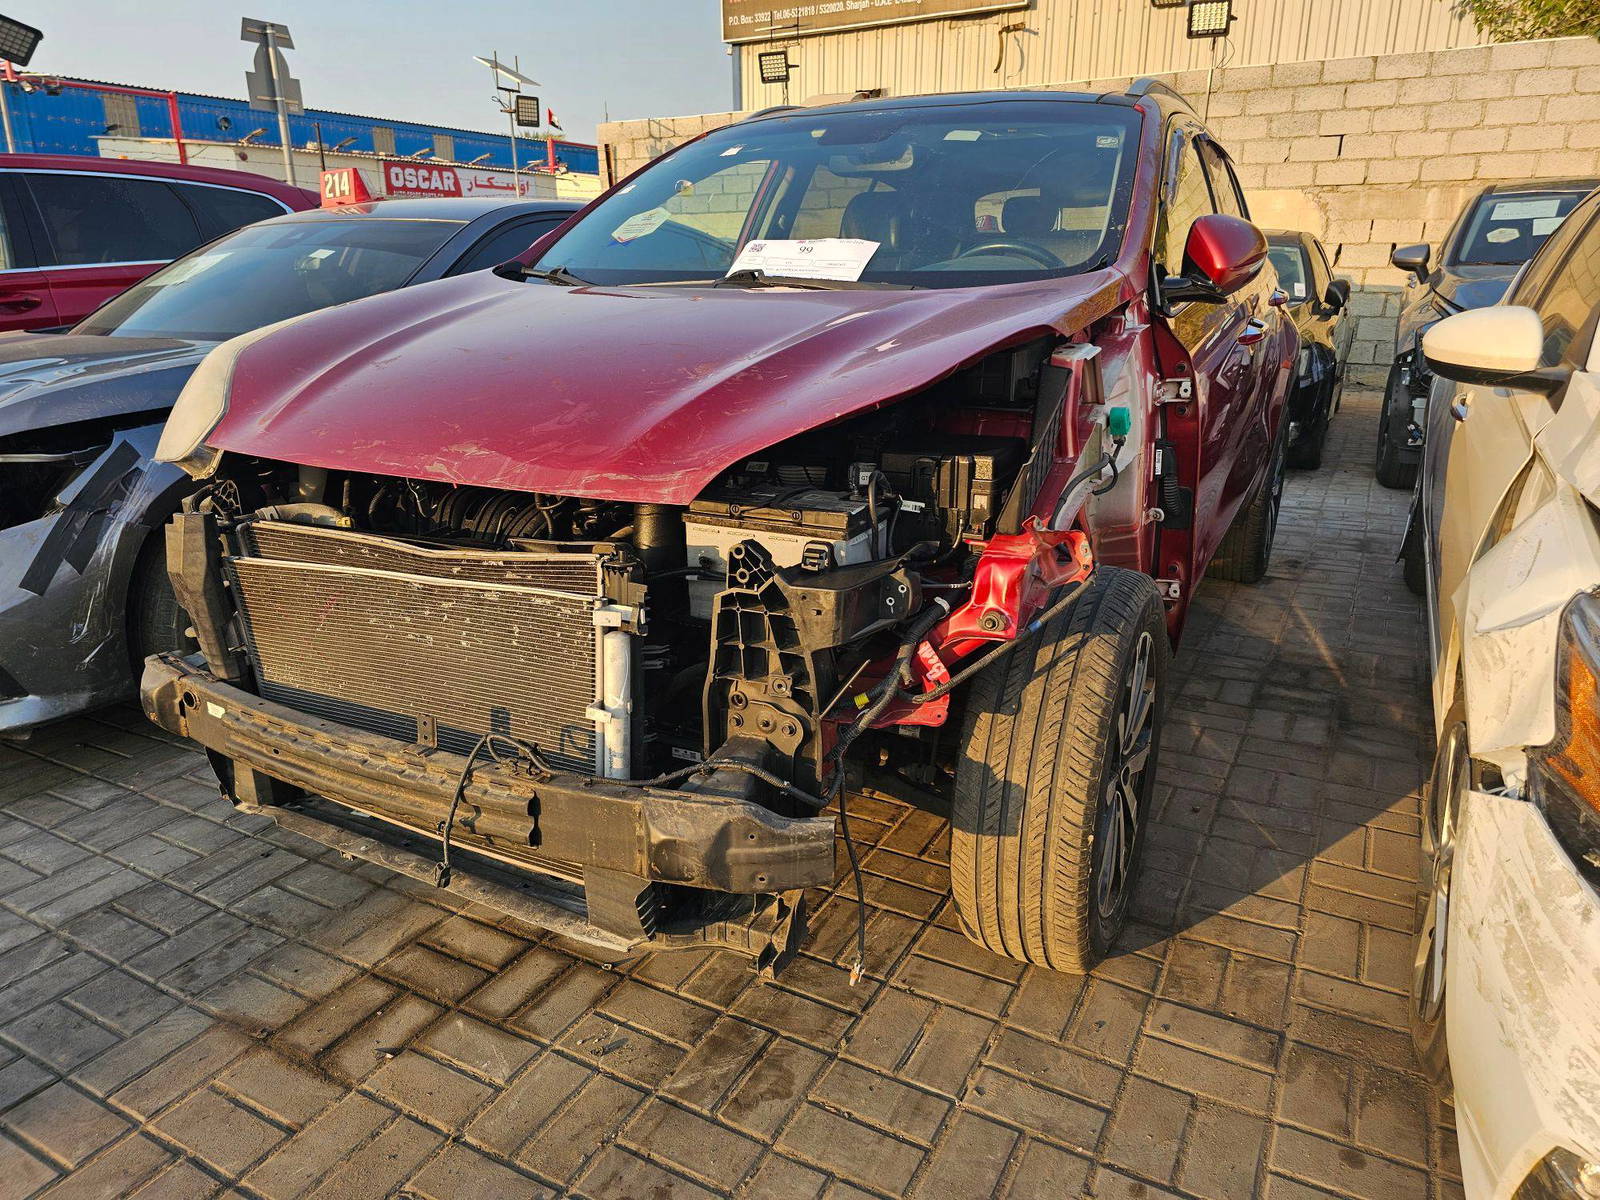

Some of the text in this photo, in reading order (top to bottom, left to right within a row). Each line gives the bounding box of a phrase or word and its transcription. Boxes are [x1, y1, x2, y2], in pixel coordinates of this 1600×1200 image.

[846, 1, 869, 11] Sharjah
[324, 171, 350, 198] 214
[390, 166, 456, 192] OSCAR
[799, 245, 814, 254] 99
